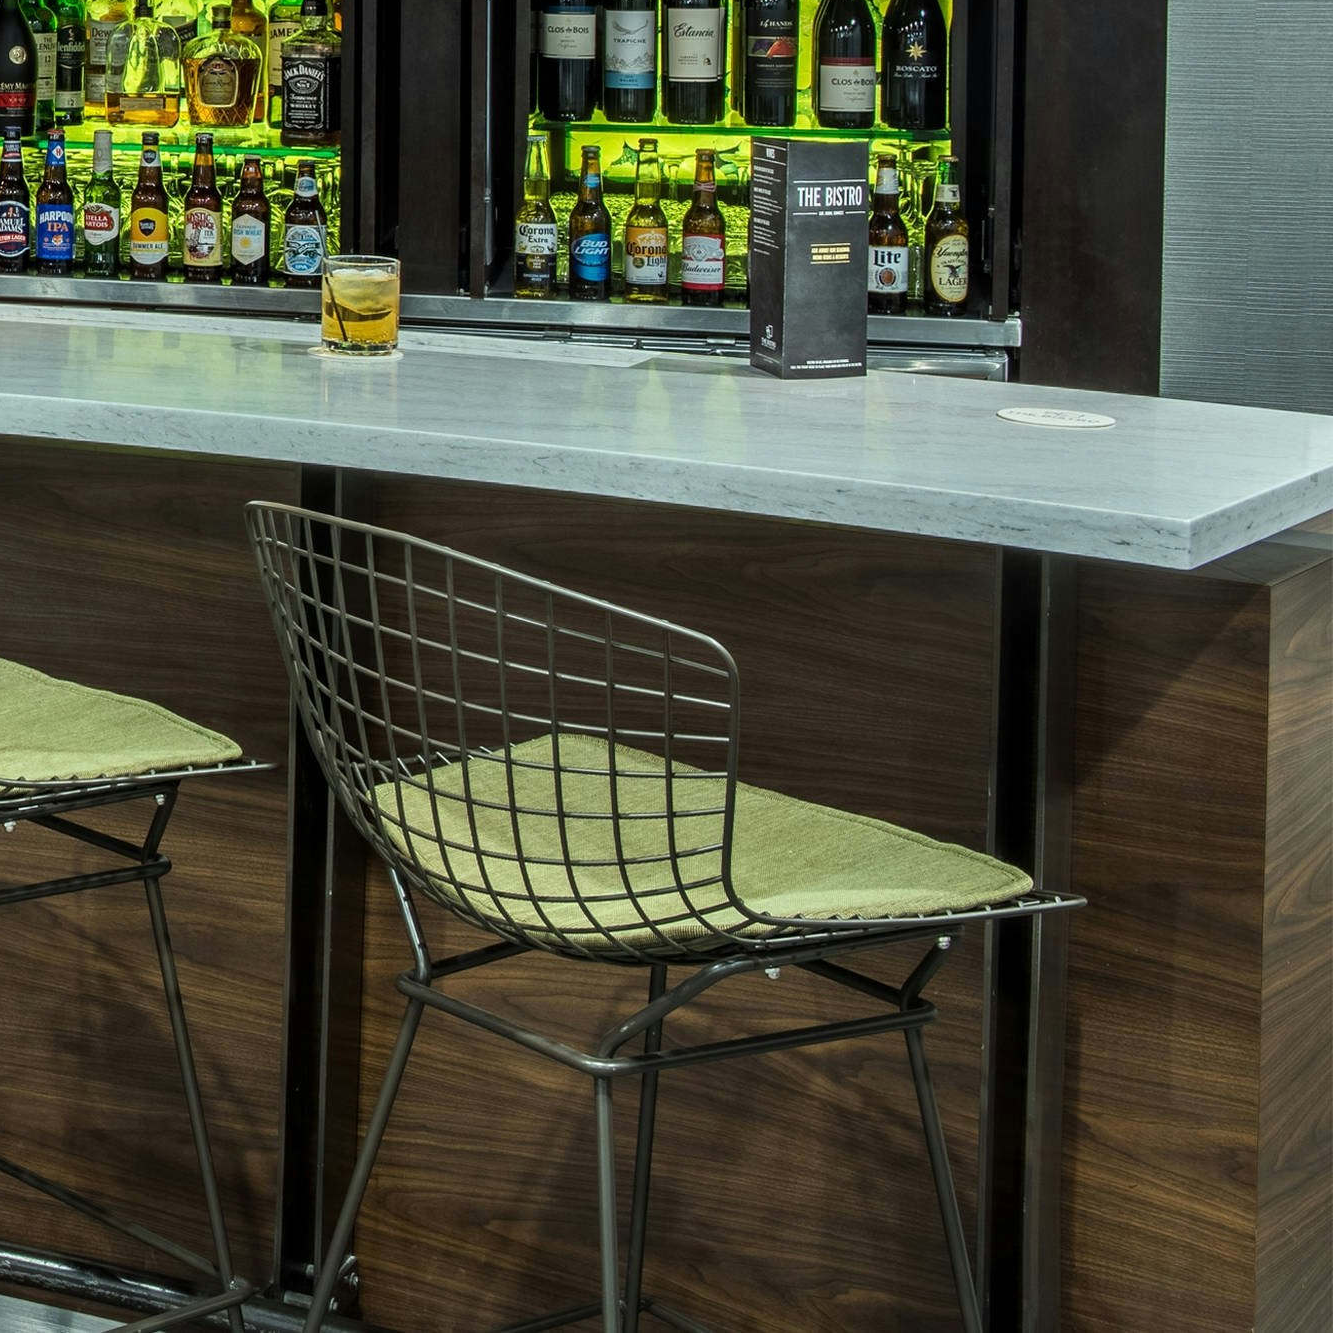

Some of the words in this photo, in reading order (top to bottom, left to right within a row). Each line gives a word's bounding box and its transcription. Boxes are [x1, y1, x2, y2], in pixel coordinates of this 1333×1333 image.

[548, 26, 564, 34] CLOS
[673, 23, 716, 38] Estancia
[284, 67, 298, 79] JACK
[797, 186, 821, 207] THE
[825, 185, 862, 206] BISTRO
[47, 222, 69, 232] IPA
[519, 224, 555, 237] Corona
[528, 235, 548, 243] Extra
[581, 239, 608, 247] BUD
[575, 247, 610, 255] LIGHT
[873, 250, 902, 266] Lite
[683, 263, 721, 274] Budweiser
